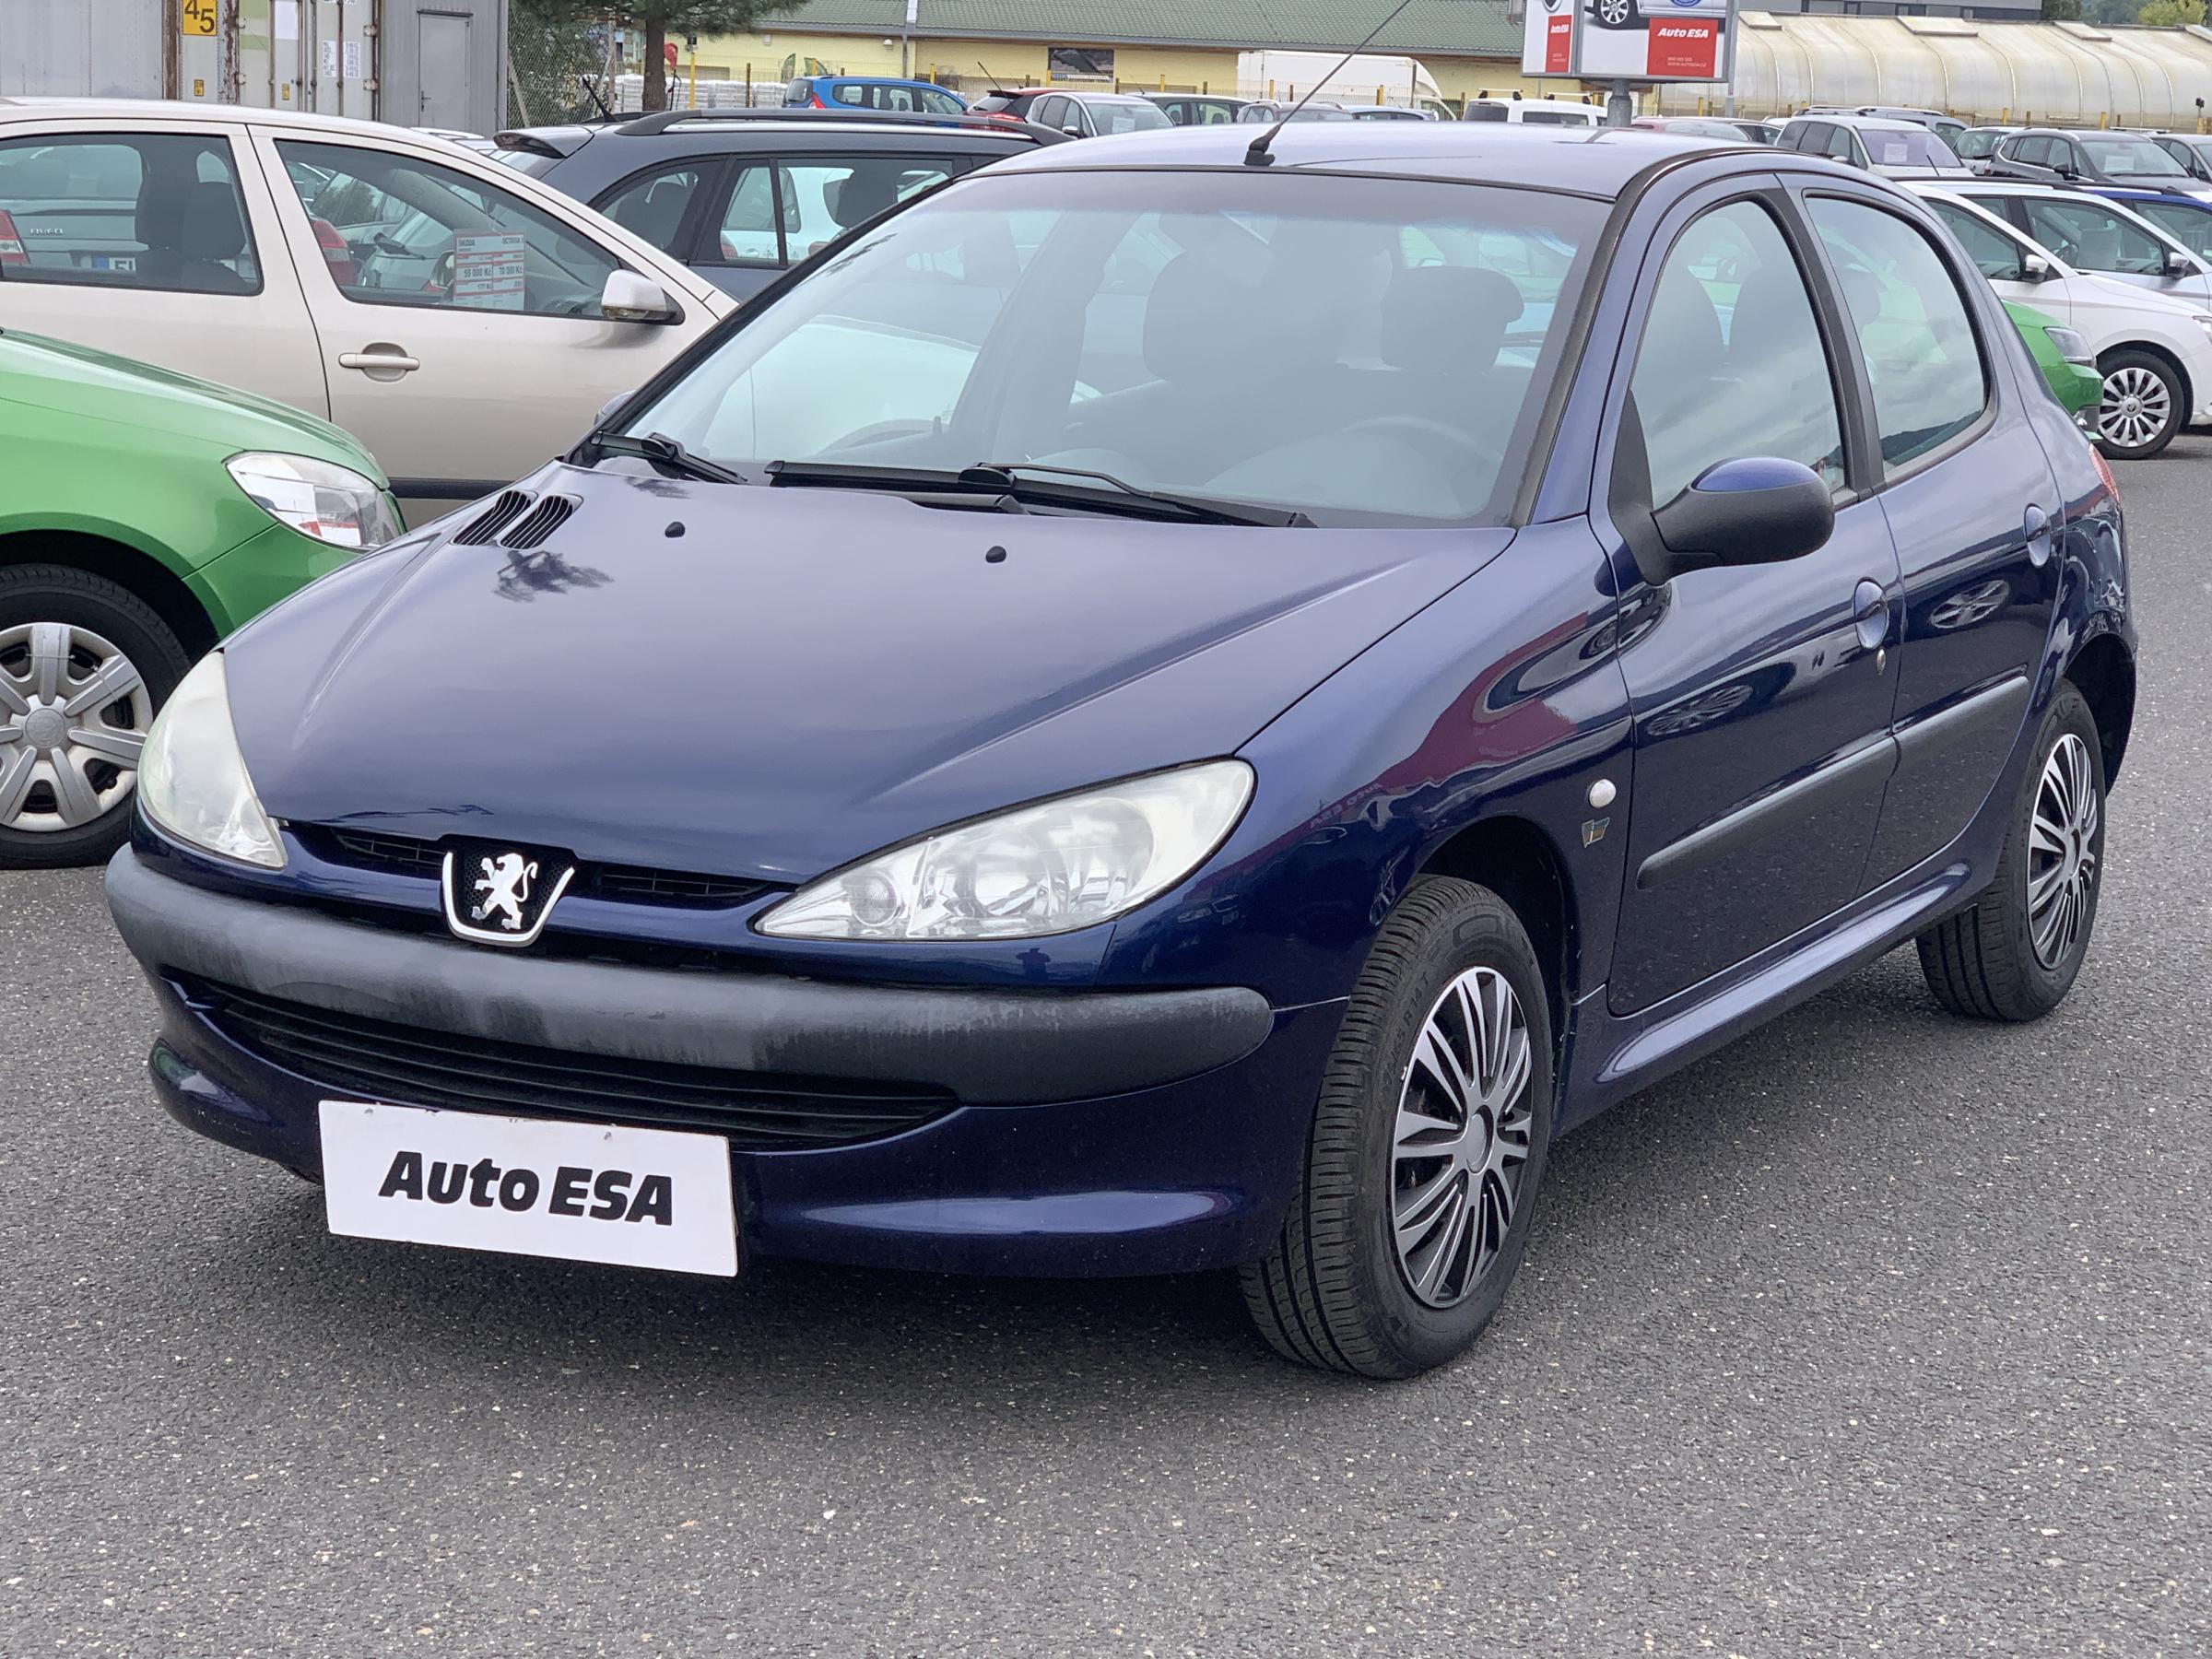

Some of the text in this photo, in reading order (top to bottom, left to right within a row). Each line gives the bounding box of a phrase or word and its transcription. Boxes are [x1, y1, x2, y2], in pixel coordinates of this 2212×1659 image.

[184, 0, 215, 33] 45
[1657, 28, 1709, 38] Auto ESA
[379, 1151, 672, 1226] Auto ESA
